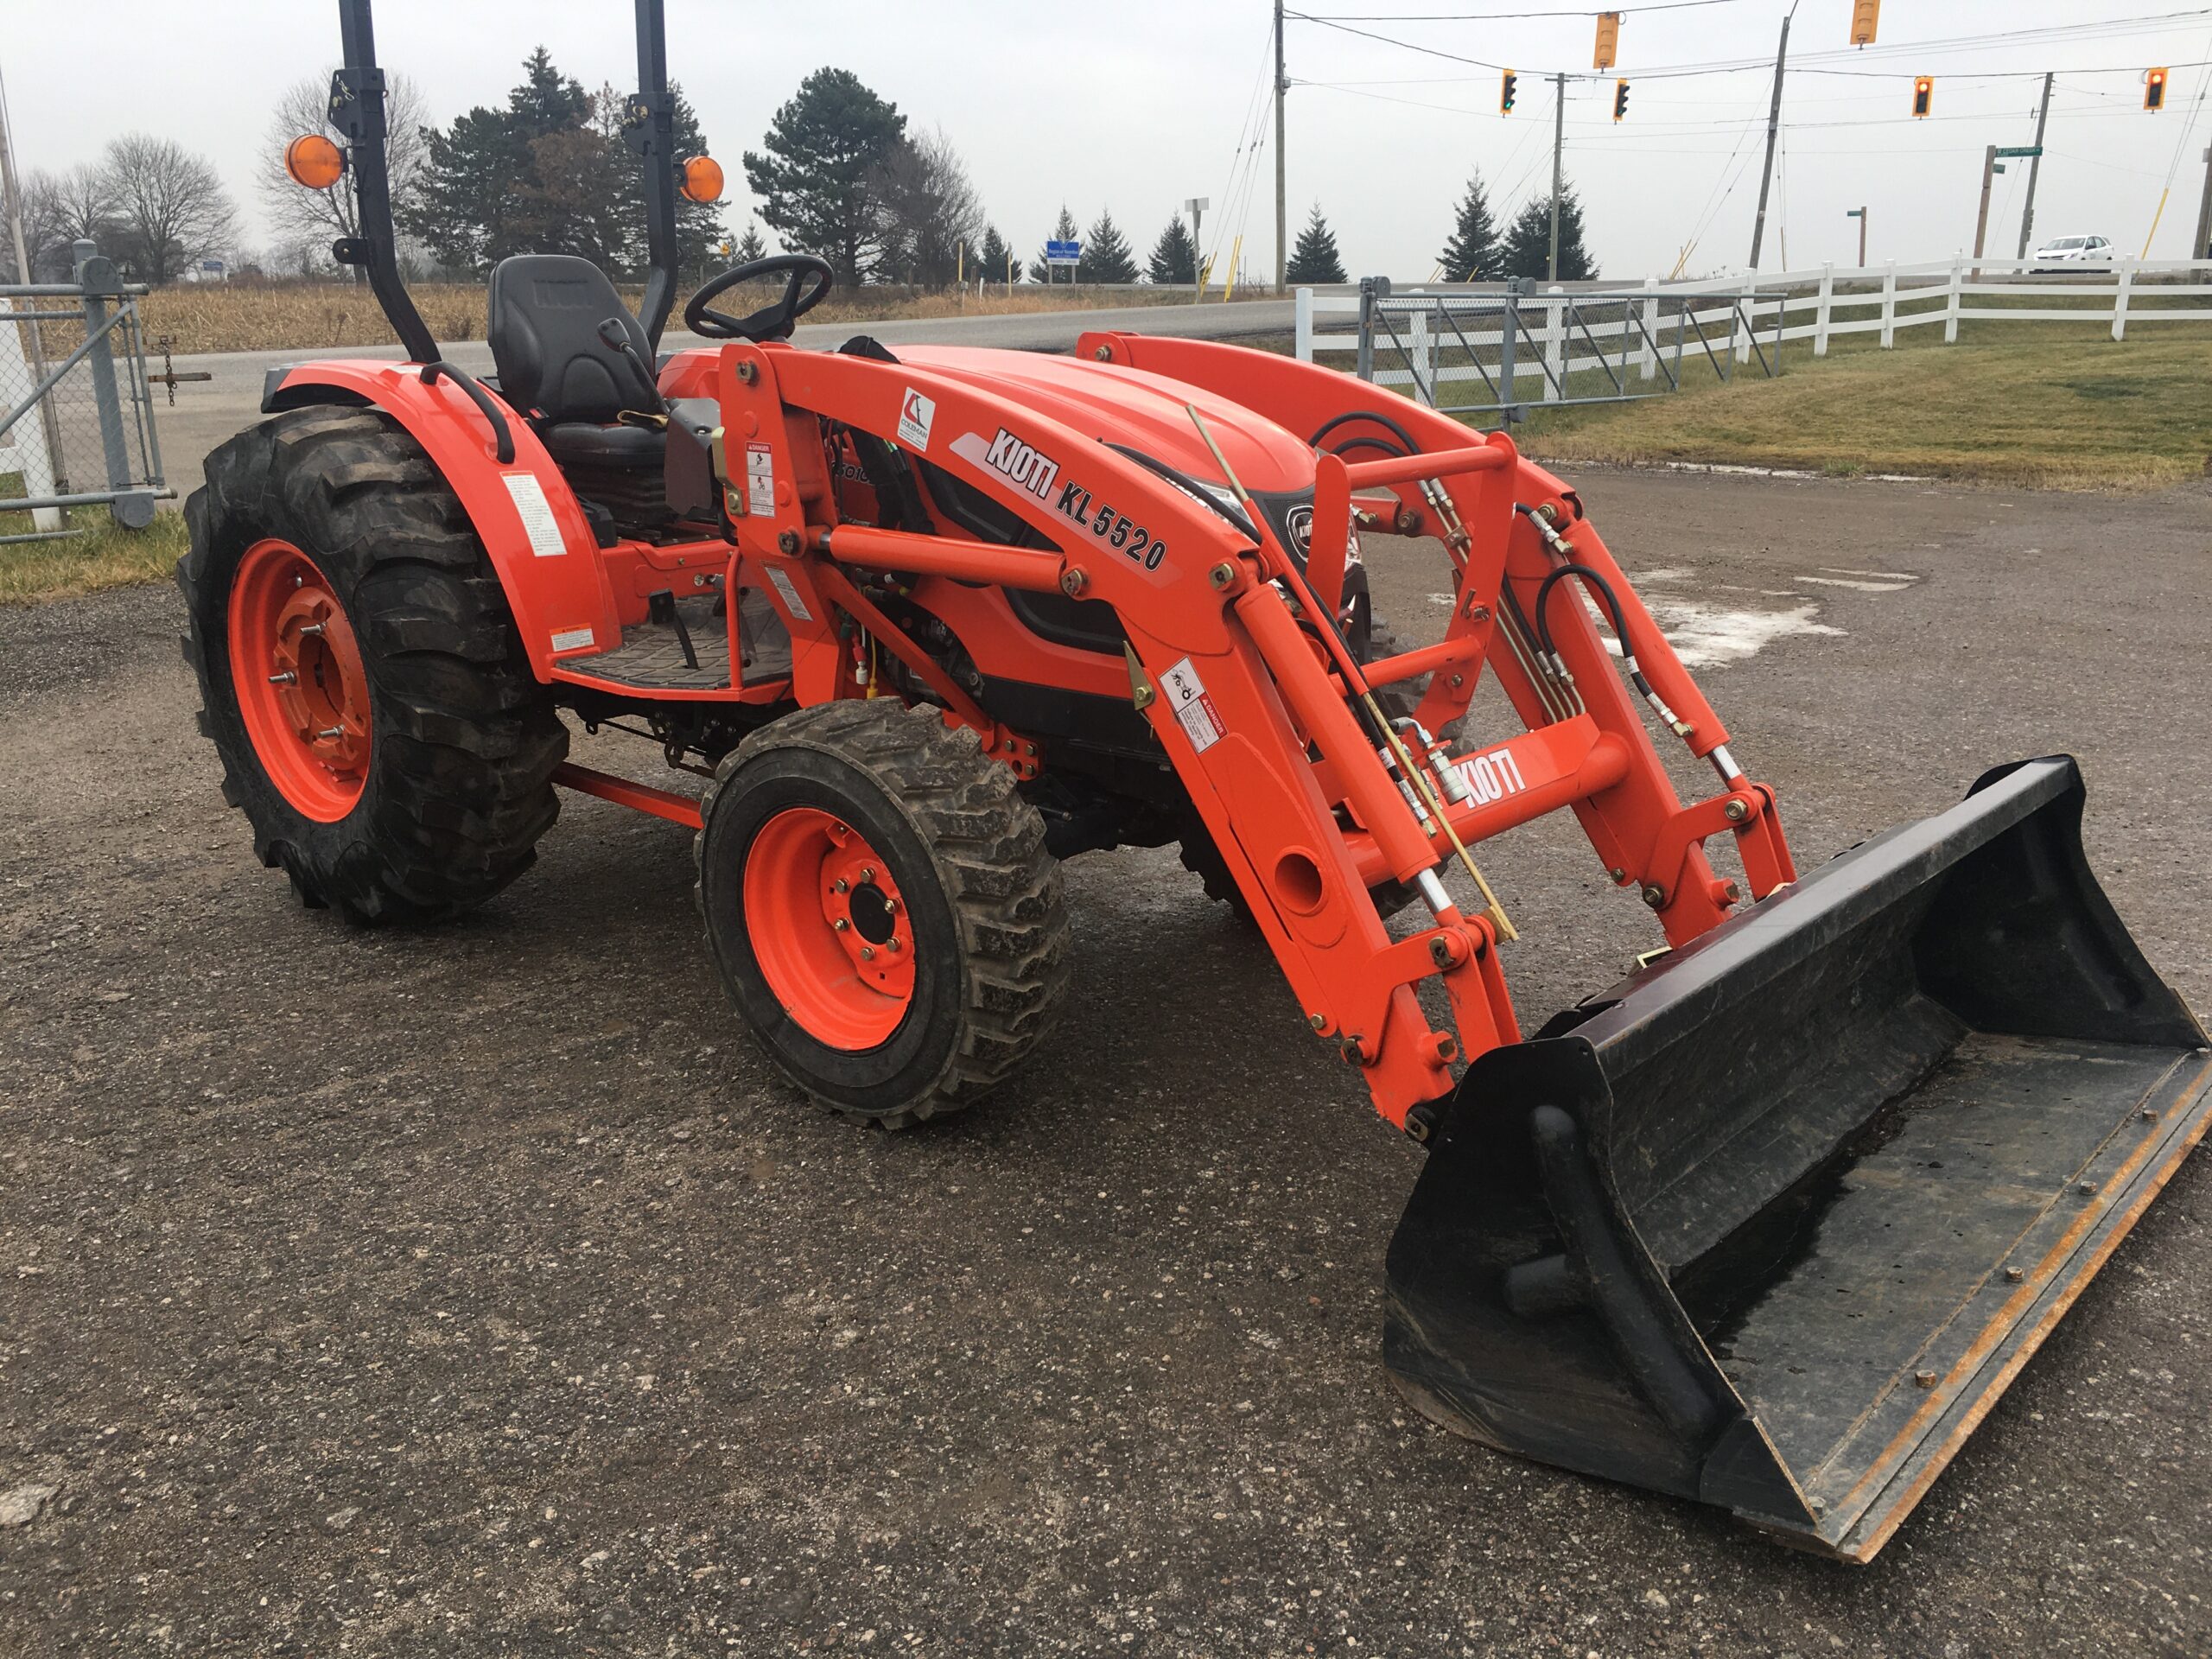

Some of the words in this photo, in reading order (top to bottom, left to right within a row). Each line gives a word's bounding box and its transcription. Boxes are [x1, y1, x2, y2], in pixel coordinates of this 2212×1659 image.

[901, 418, 927, 439] COLEMAN
[985, 427, 1060, 500] KIOTI
[1205, 704, 1224, 734] DANGER
[1452, 747, 1526, 810] KIOTI
